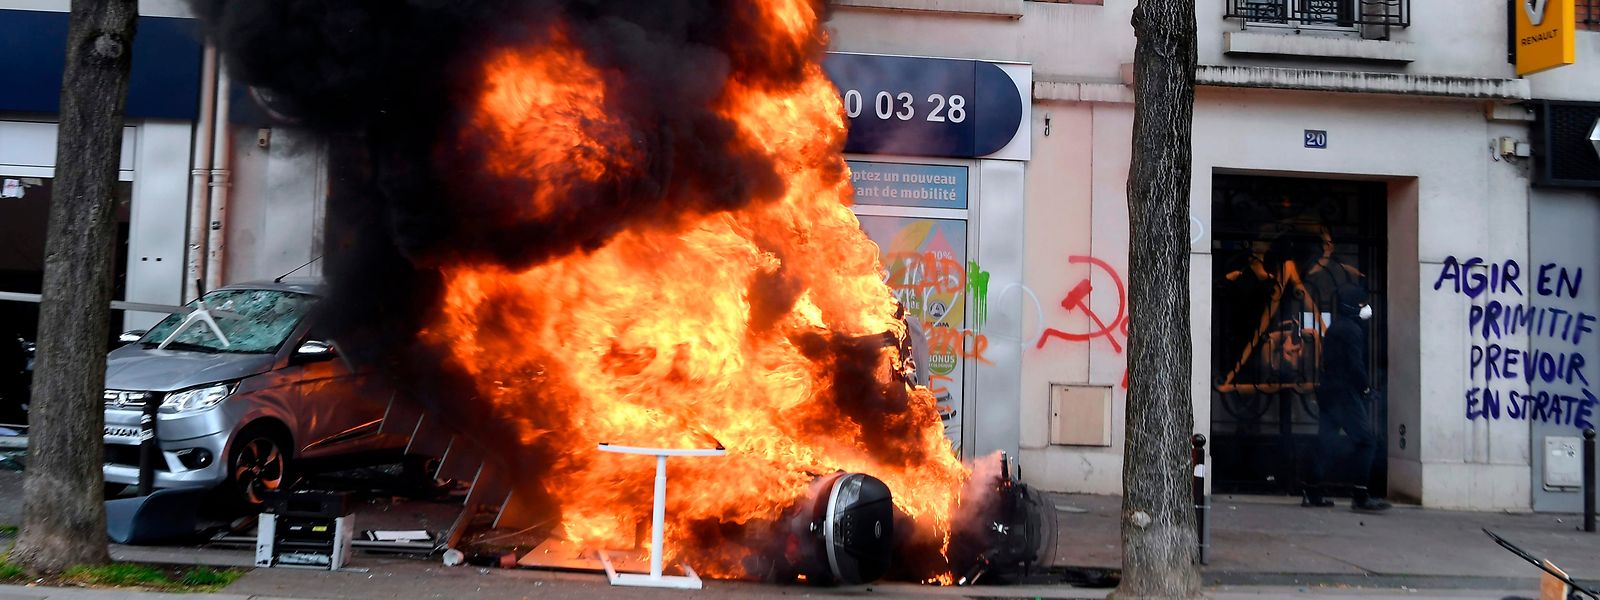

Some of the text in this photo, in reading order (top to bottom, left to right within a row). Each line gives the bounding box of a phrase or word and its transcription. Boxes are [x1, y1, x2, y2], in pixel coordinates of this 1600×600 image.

[1521, 29, 1558, 47] RENAULT
[875, 91, 915, 120] 03
[926, 93, 966, 123] 28
[1306, 132, 1325, 146] 20
[851, 170, 956, 185] ptez un nouveau
[856, 186, 956, 201] ant de mobilité
[1434, 255, 1583, 299] AGIR EN
[1469, 300, 1597, 345] PRIMITIF
[1470, 344, 1589, 386] PREVOIR
[1465, 387, 1500, 420] EN
